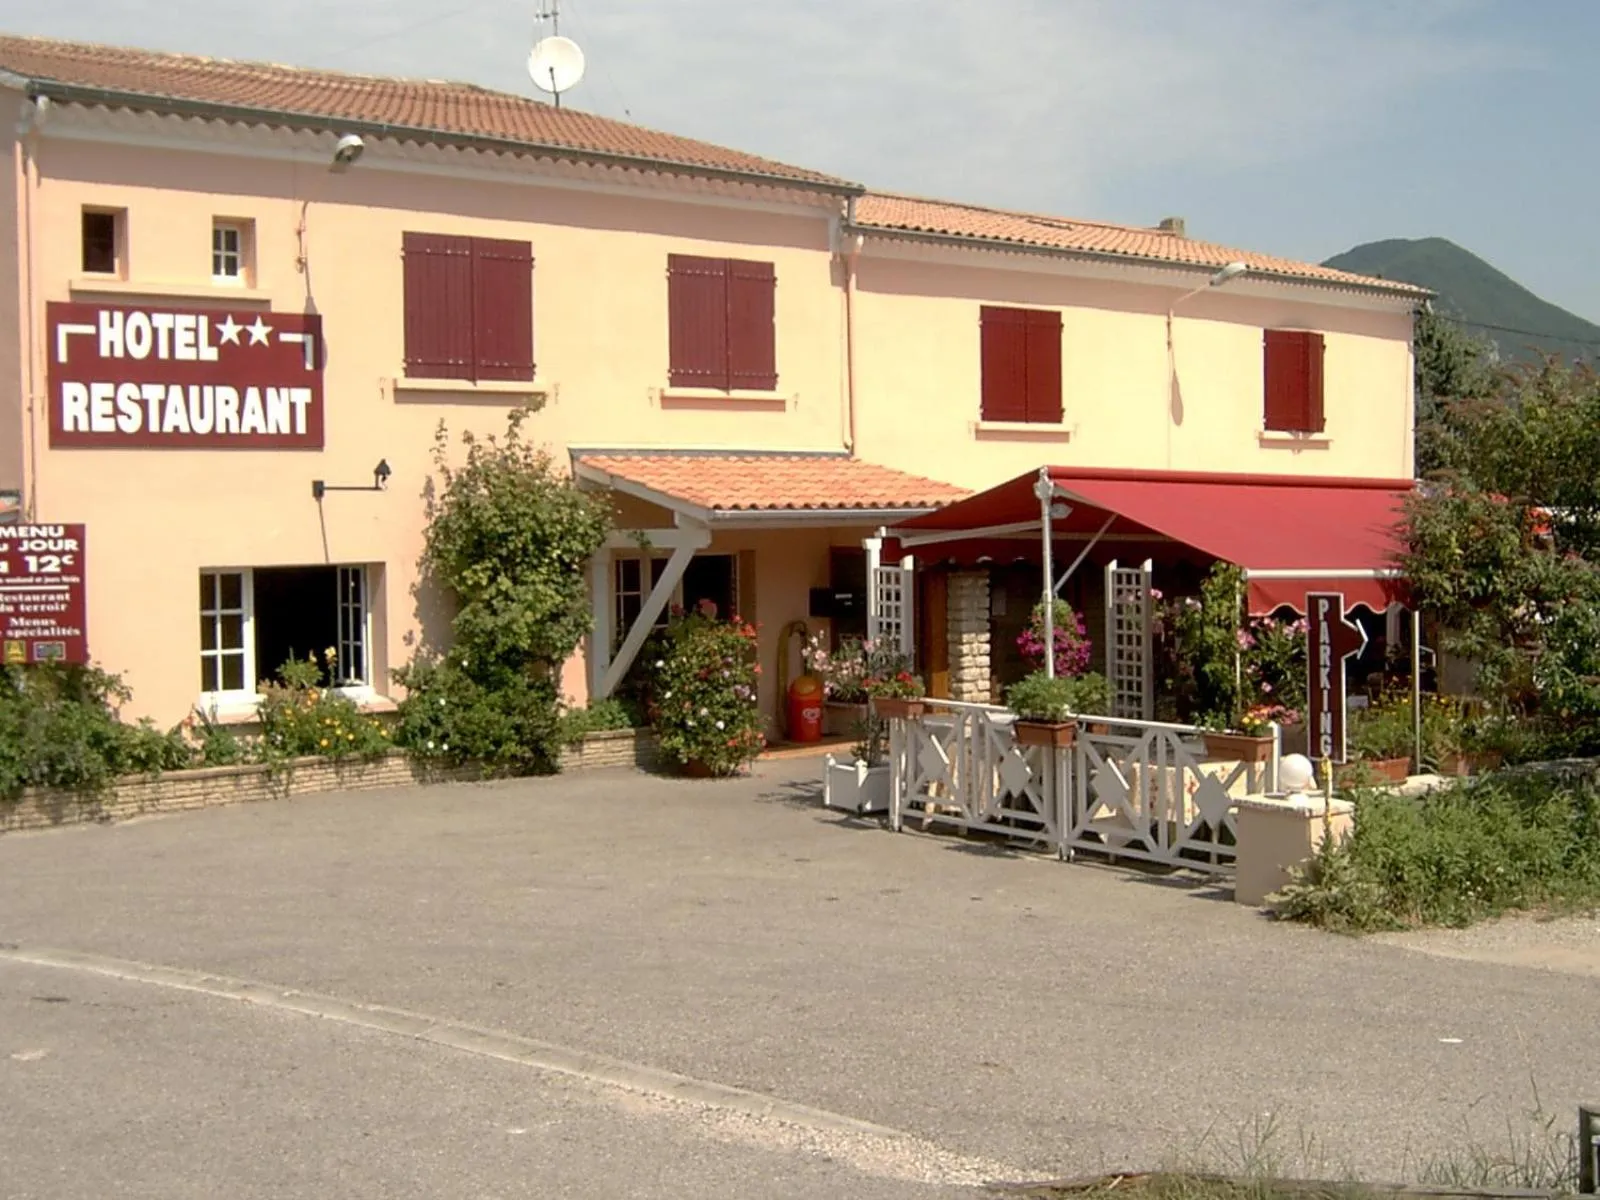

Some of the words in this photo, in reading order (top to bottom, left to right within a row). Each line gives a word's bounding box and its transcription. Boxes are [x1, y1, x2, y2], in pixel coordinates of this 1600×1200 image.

[99, 310, 219, 361] HOTEL
[62, 382, 312, 434] RESTAURANT
[0, 525, 64, 538] MENU
[18, 539, 80, 551] JOUR
[20, 603, 67, 612] terroir
[10, 617, 56, 627] Menus
[1318, 599, 1332, 755] PARKING
